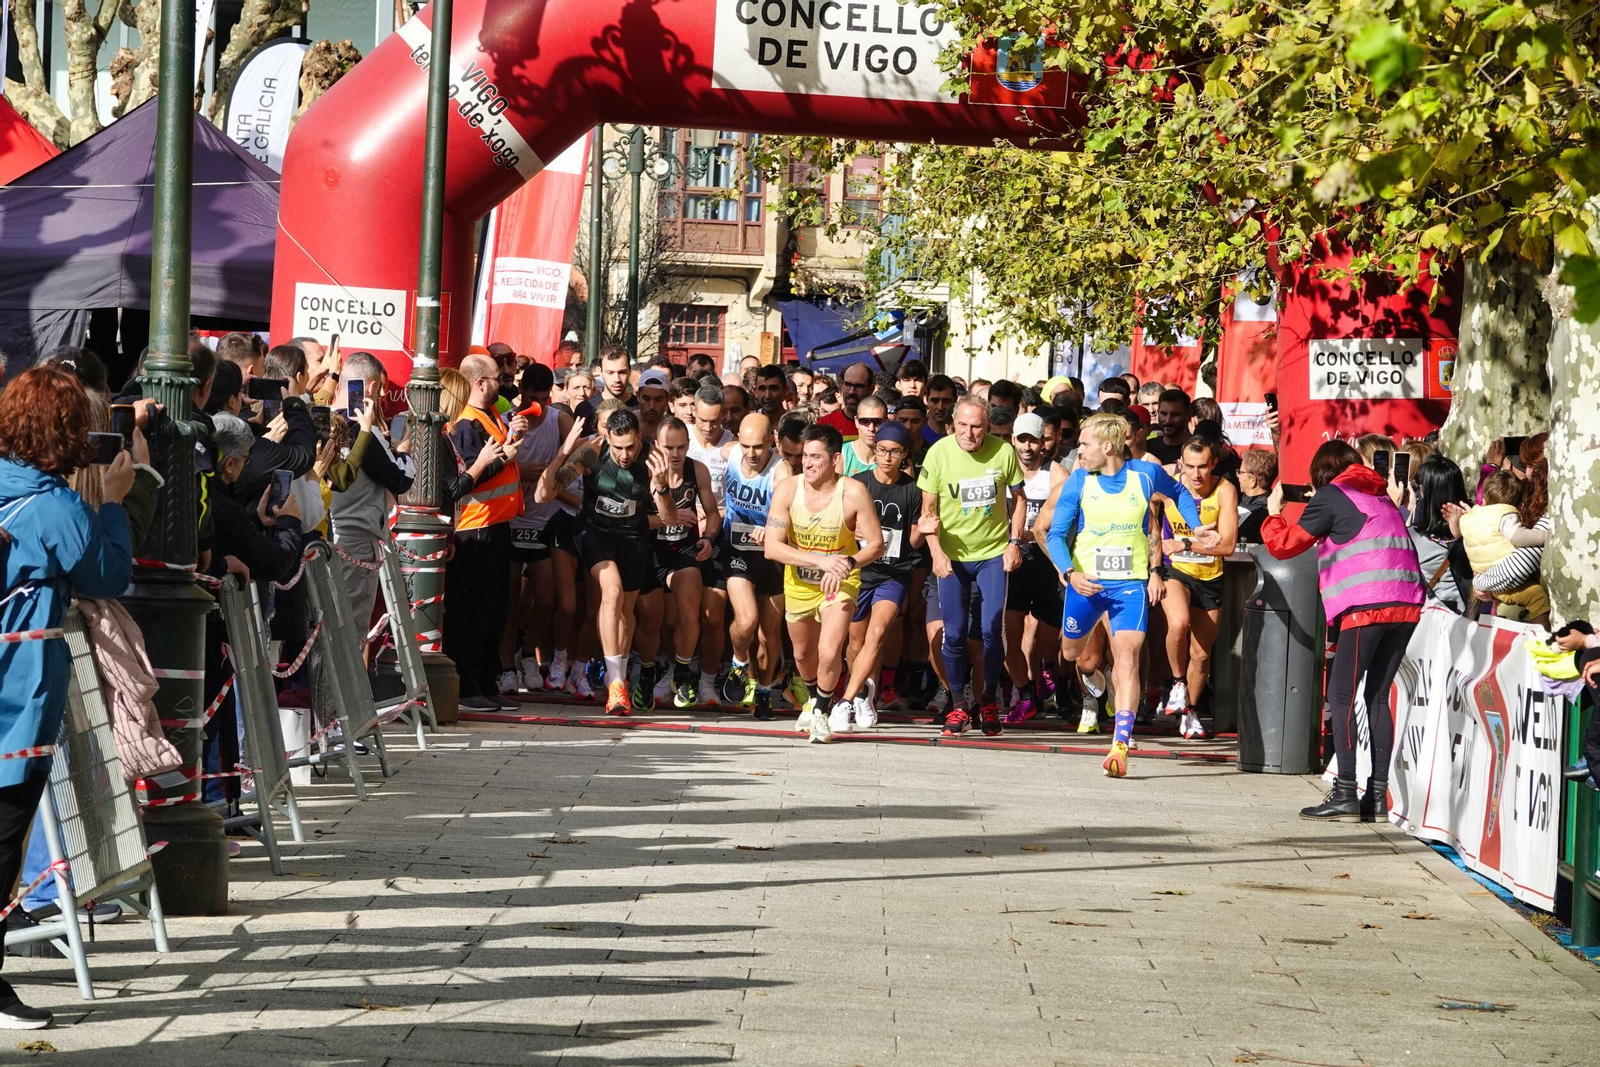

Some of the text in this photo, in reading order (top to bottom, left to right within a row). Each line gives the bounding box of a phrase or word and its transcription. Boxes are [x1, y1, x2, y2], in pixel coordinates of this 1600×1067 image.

[735, 0, 945, 36] CONCELLO
[758, 37, 918, 75] DE VIGO
[254, 77, 278, 150] GALICIA
[458, 101, 485, 128] de
[481, 127, 520, 168] xogo
[523, 278, 560, 292] CIDADE
[301, 296, 396, 317] CONCELLO
[530, 291, 557, 304] VIVIR
[309, 316, 383, 336] DE VIGO
[1316, 351, 1414, 366] CONCELLO
[1327, 370, 1404, 386] DE VIGO
[726, 479, 768, 506] ADN
[967, 486, 991, 500] 695
[516, 529, 538, 541] 252
[1102, 556, 1126, 569] 681
